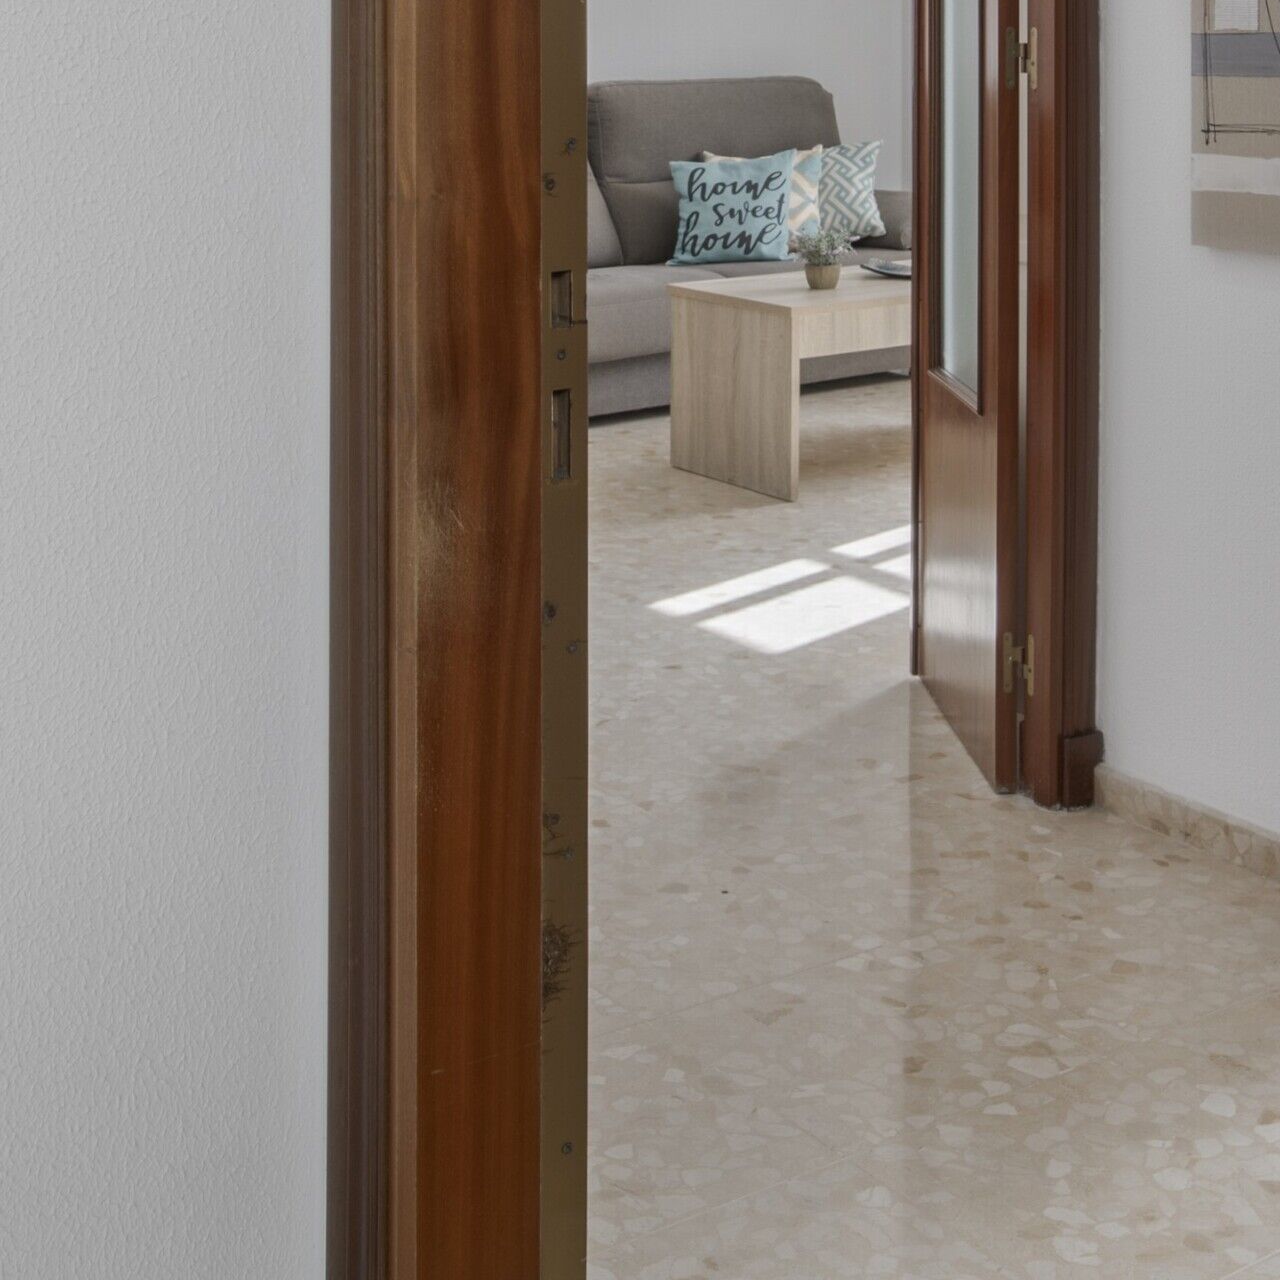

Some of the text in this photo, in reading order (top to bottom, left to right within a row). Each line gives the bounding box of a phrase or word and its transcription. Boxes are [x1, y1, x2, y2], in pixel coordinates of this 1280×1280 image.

[687, 167, 786, 202] home
[712, 193, 786, 227] sweet
[681, 211, 782, 257] home
